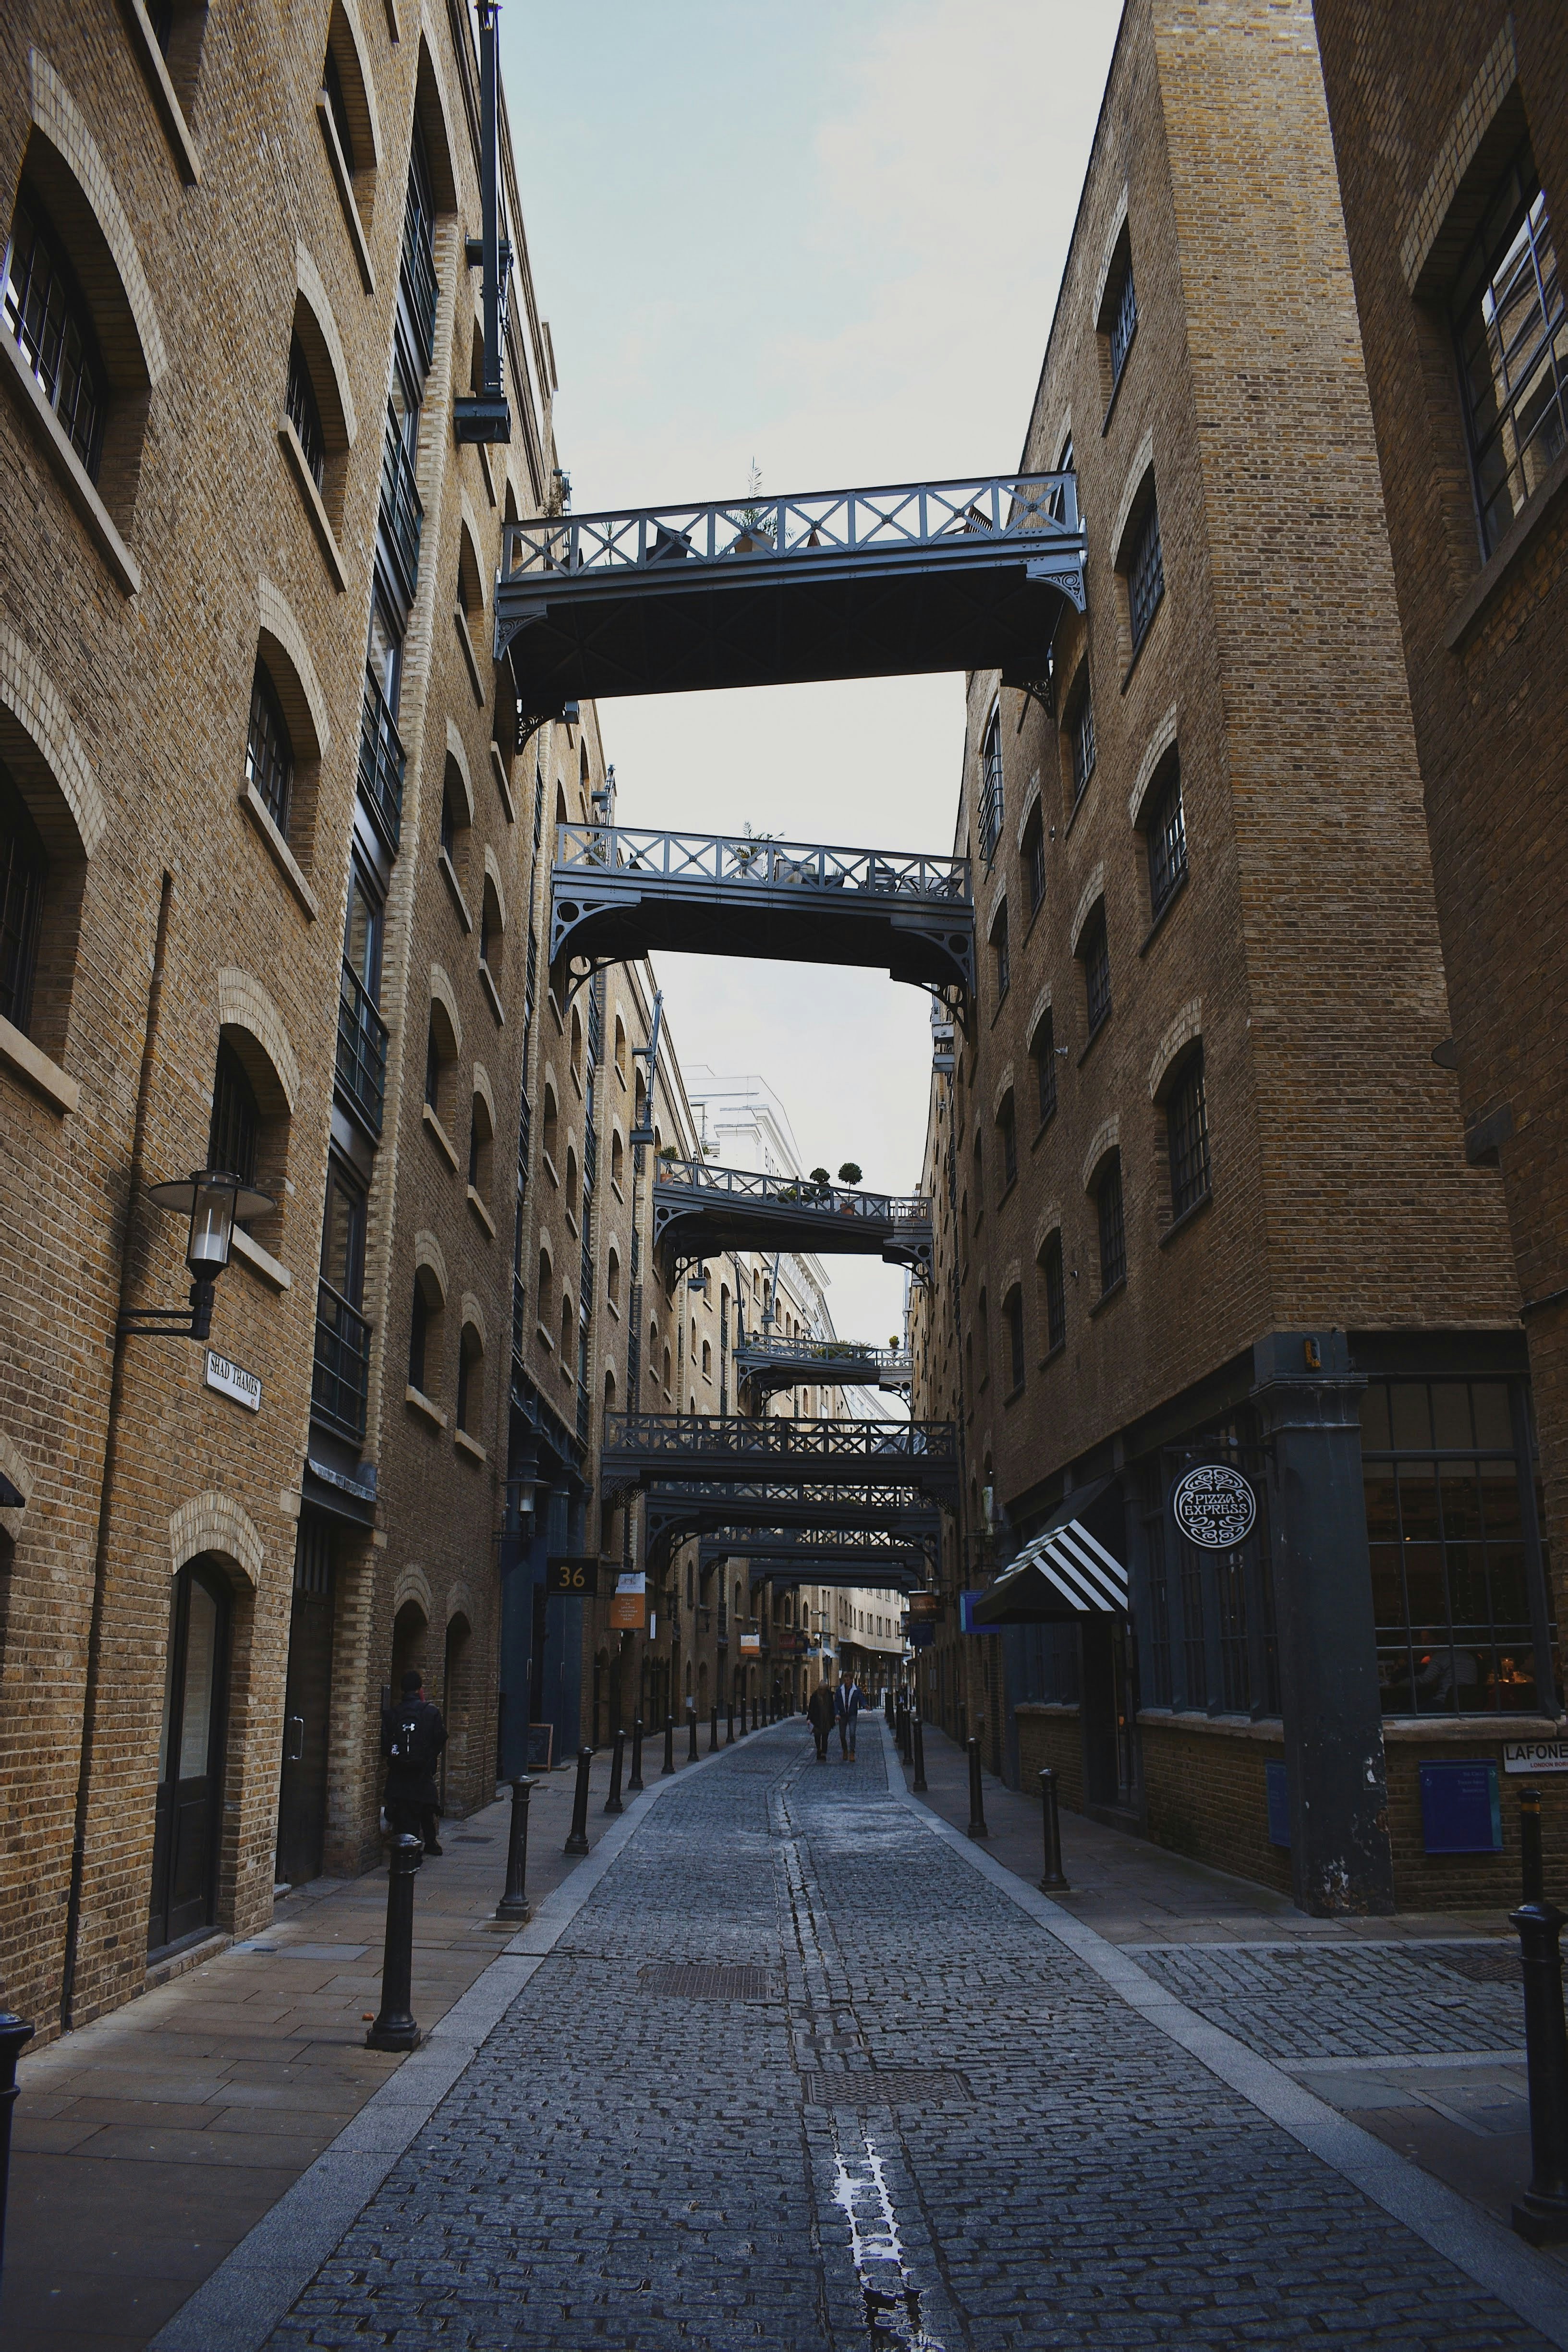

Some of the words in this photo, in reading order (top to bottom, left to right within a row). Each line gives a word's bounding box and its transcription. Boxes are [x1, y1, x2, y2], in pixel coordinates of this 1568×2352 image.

[210, 1354, 230, 1379] SHAD
[232, 1367, 258, 1396] THAMES
[1195, 1494, 1236, 1504] PIZZA
[1184, 1503, 1248, 1515] EXPRESS
[559, 1566, 585, 1588] 36
[1506, 1744, 1568, 1760] LAFONE
